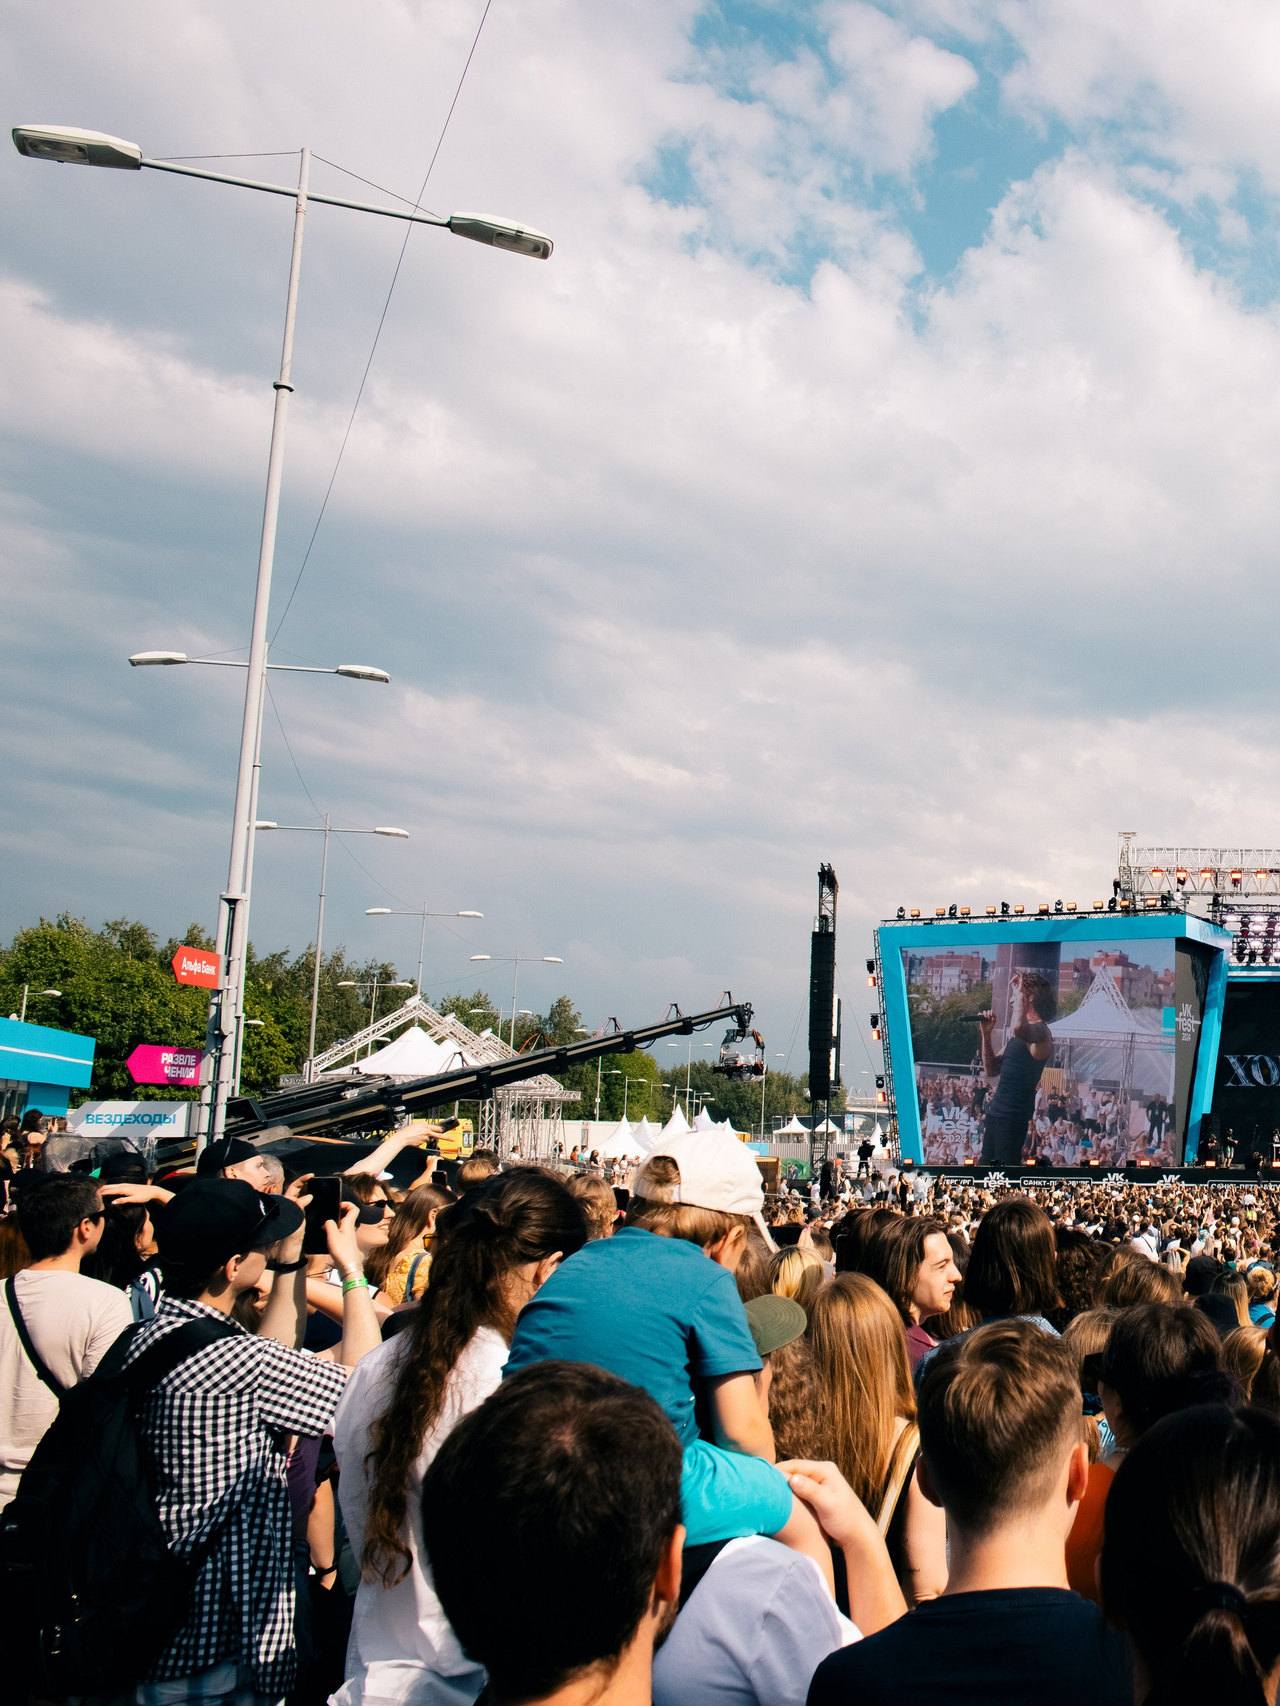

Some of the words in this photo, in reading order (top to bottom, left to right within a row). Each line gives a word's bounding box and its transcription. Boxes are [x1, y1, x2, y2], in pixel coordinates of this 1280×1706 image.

[181, 956, 201, 976] Альфа
[201, 960, 217, 976] Банк
[1181, 1003, 1193, 1017] VK
[1177, 1012, 1196, 1033] fest
[161, 1052, 197, 1066] РАЗВЛЕ
[164, 1065, 196, 1079] ЧЕНИЯ
[85, 1113, 176, 1127] ВЕЗДЕХОДЫ
[941, 1106, 968, 1120] VK
[988, 1171, 1006, 1180] VK
[1107, 1172, 1125, 1182] VK
